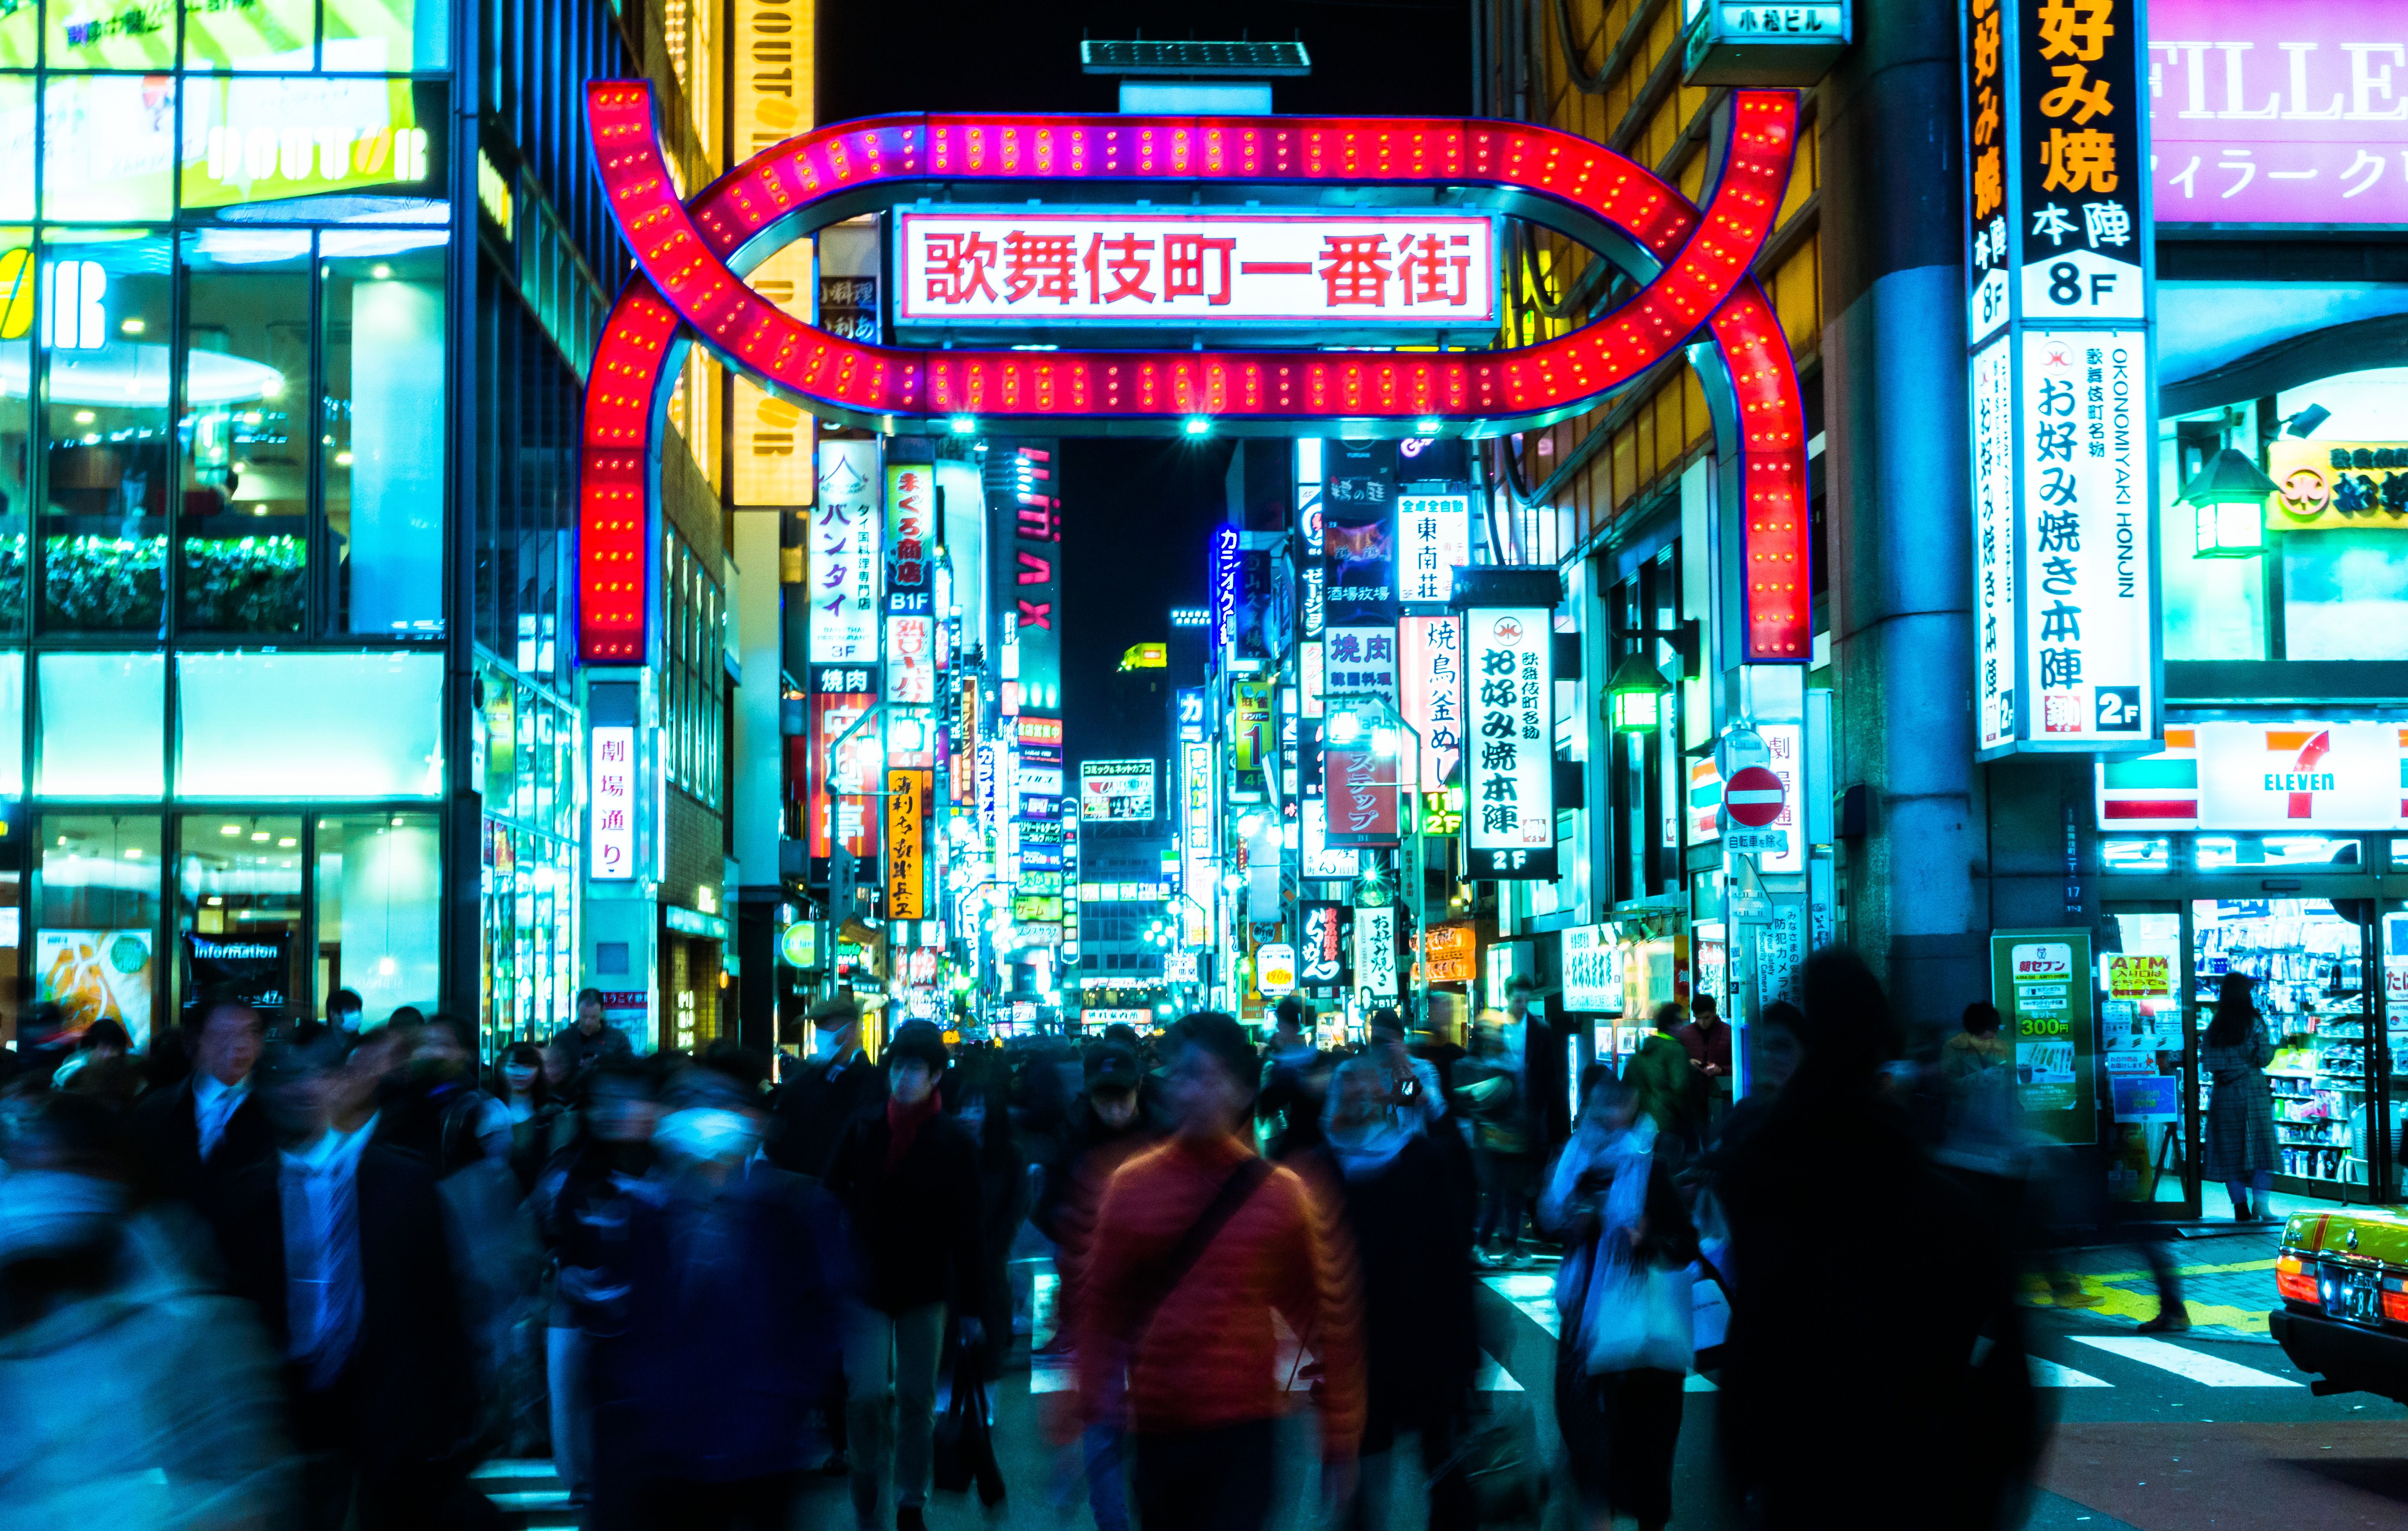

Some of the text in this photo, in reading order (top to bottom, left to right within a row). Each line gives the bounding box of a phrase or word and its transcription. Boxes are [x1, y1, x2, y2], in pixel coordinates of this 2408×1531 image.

[1738, 9, 1822, 32] 小松ビル
[207, 125, 428, 181] DOUTOR
[2033, 201, 2131, 248] 本陣
[1975, 215, 2006, 269] 本陣
[925, 231, 1471, 306] 歌舞伎町一番街
[2049, 262, 2117, 306] 8F
[1983, 283, 2004, 324] 8F
[2086, 348, 2105, 458] 歌舞伎町名物
[2112, 348, 2135, 598] OKONOMIYAKI HONJIN
[1402, 500, 1464, 513] 全卓全自動
[2037, 378, 2083, 690] お好み焼き本陣
[819, 504, 851, 617] バンタイ
[857, 504, 871, 611] タイ国料理専門店
[1417, 517, 1438, 598] 東南荘
[890, 594, 929, 611] B1F
[1402, 589, 1414, 598] 3F
[832, 645, 856, 657] 3F
[1331, 633, 1392, 663] 焼肉
[821, 669, 868, 692] 焼肉
[1426, 620, 1458, 790] 焼鳥釜めし
[1521, 652, 1540, 740] 歌舞伎町名物
[2099, 693, 2139, 724] 2F
[2001, 701, 2014, 728] 2F
[1243, 724, 1263, 767] 1
[1481, 648, 1519, 834] お好み焼本陣
[1084, 764, 1151, 775] コミック&ネットカフェ
[2264, 773, 2334, 791] ELEVEN
[601, 740, 624, 865] 劇場通り
[1427, 815, 1463, 833] 2F
[1729, 835, 1783, 849] 自転車を除く
[1493, 851, 1527, 870] 2F
[2067, 887, 2080, 898] 17
[195, 942, 278, 959] Information
[1370, 914, 1393, 987] お好み焼き
[1759, 932, 1767, 961] Security
[1266, 970, 1292, 981] 190円
[2019, 960, 2065, 972] 朝セブン
[2111, 957, 2169, 969] ATM
[1760, 964, 1768, 993] Camera
[1378, 998, 1398, 1008] B1F
[2021, 1019, 2070, 1035] 300円
